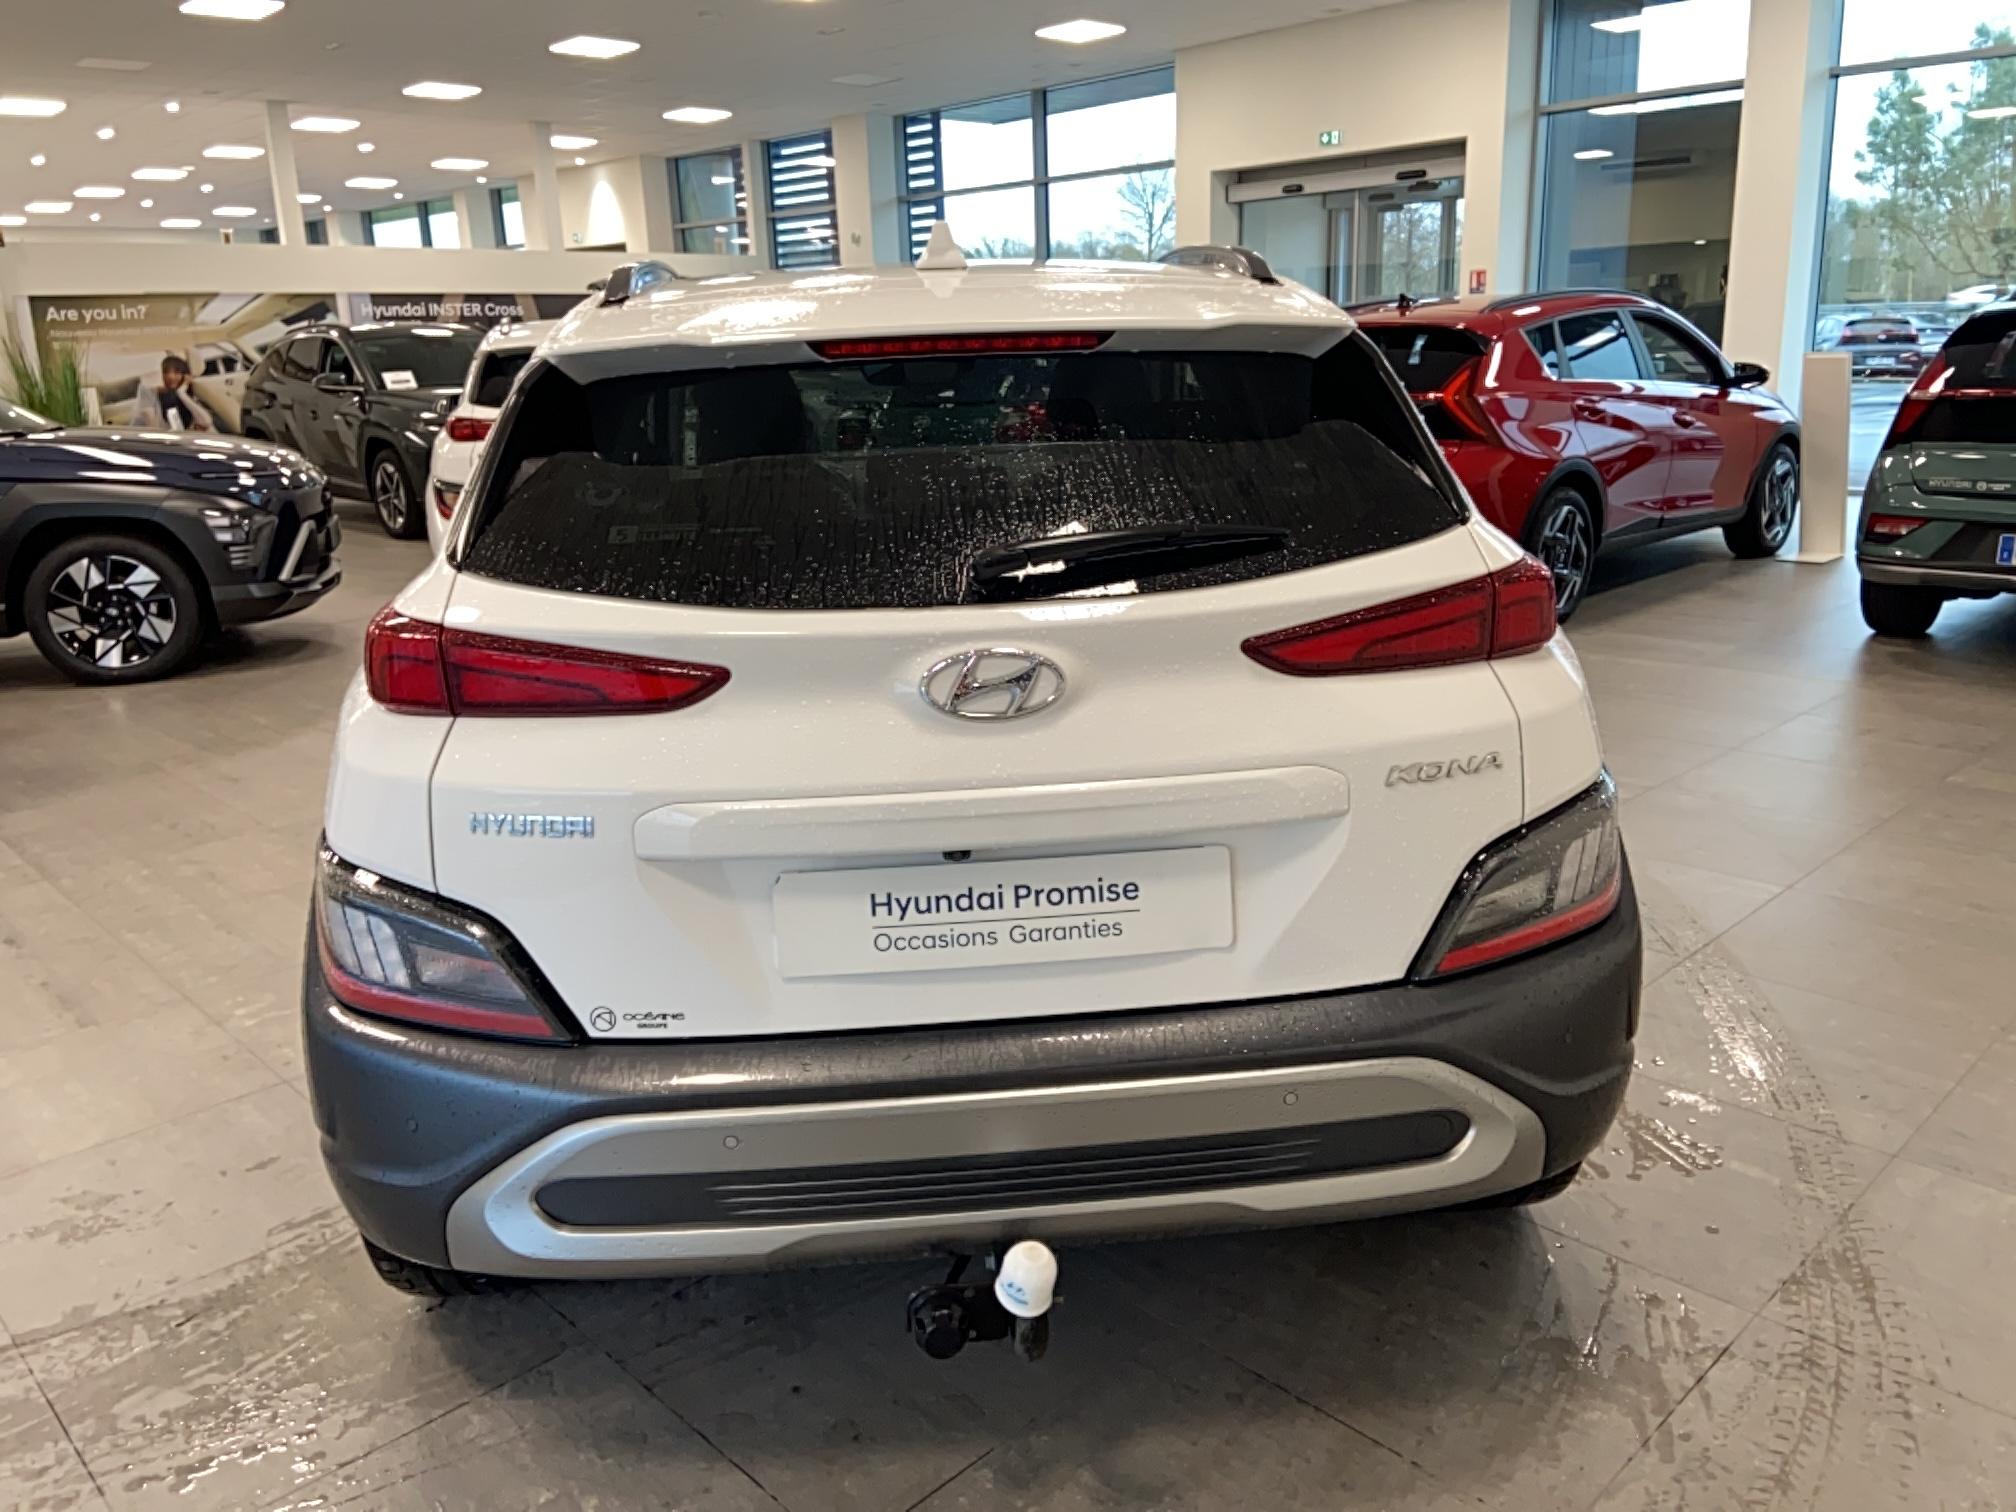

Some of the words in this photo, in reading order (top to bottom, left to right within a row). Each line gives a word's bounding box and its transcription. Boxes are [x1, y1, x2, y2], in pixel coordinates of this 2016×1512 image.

[46, 306, 78, 321] Are
[83, 309, 117, 323] you
[120, 304, 148, 320] in?
[361, 302, 427, 319] Hyundai
[429, 303, 484, 316] INSTER
[485, 303, 524, 316] Cross
[1384, 751, 1503, 787] KONA
[469, 811, 595, 838] HYUNDAI
[870, 884, 1004, 921] Hyundai
[1014, 877, 1140, 908] Promise
[873, 928, 998, 952] Occasions
[1009, 918, 1123, 944] Garanties
